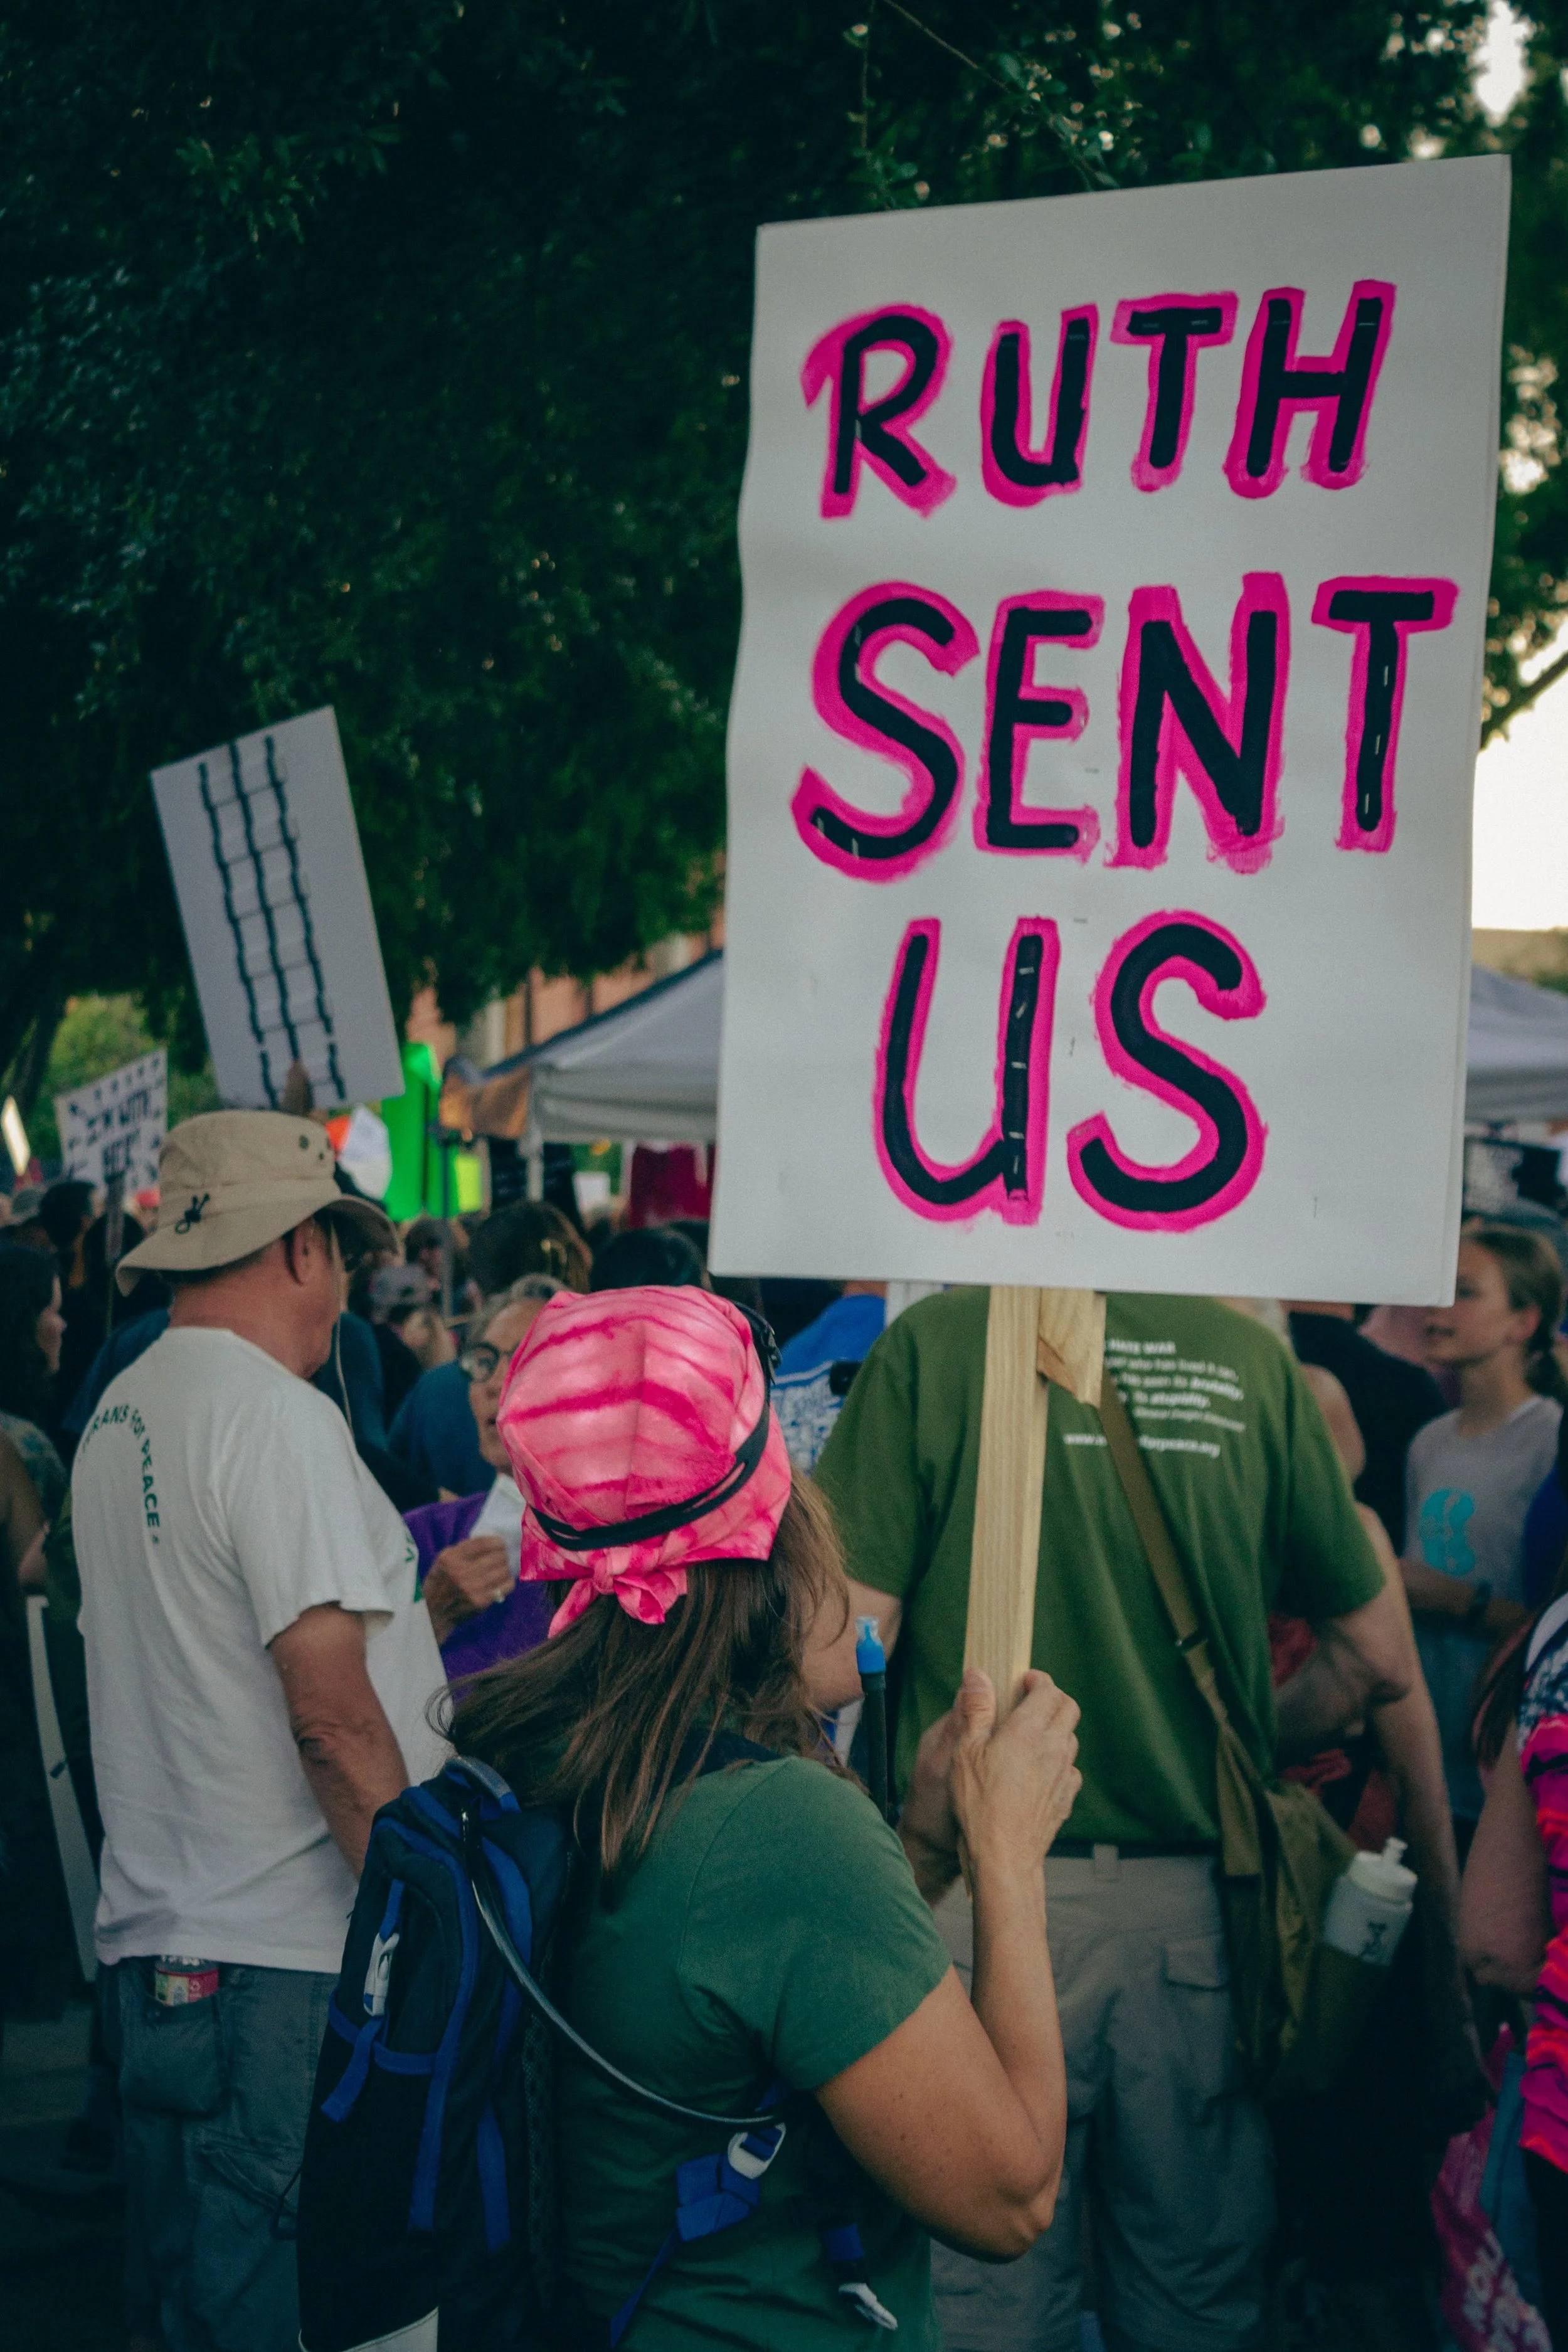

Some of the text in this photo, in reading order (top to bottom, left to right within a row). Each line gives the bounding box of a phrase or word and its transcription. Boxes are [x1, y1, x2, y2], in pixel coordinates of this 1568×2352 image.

[800, 279, 1396, 521] RUTH
[789, 571, 1460, 885] SENT
[871, 909, 1269, 1234] US
[140, 1438, 161, 1527] PEACE
